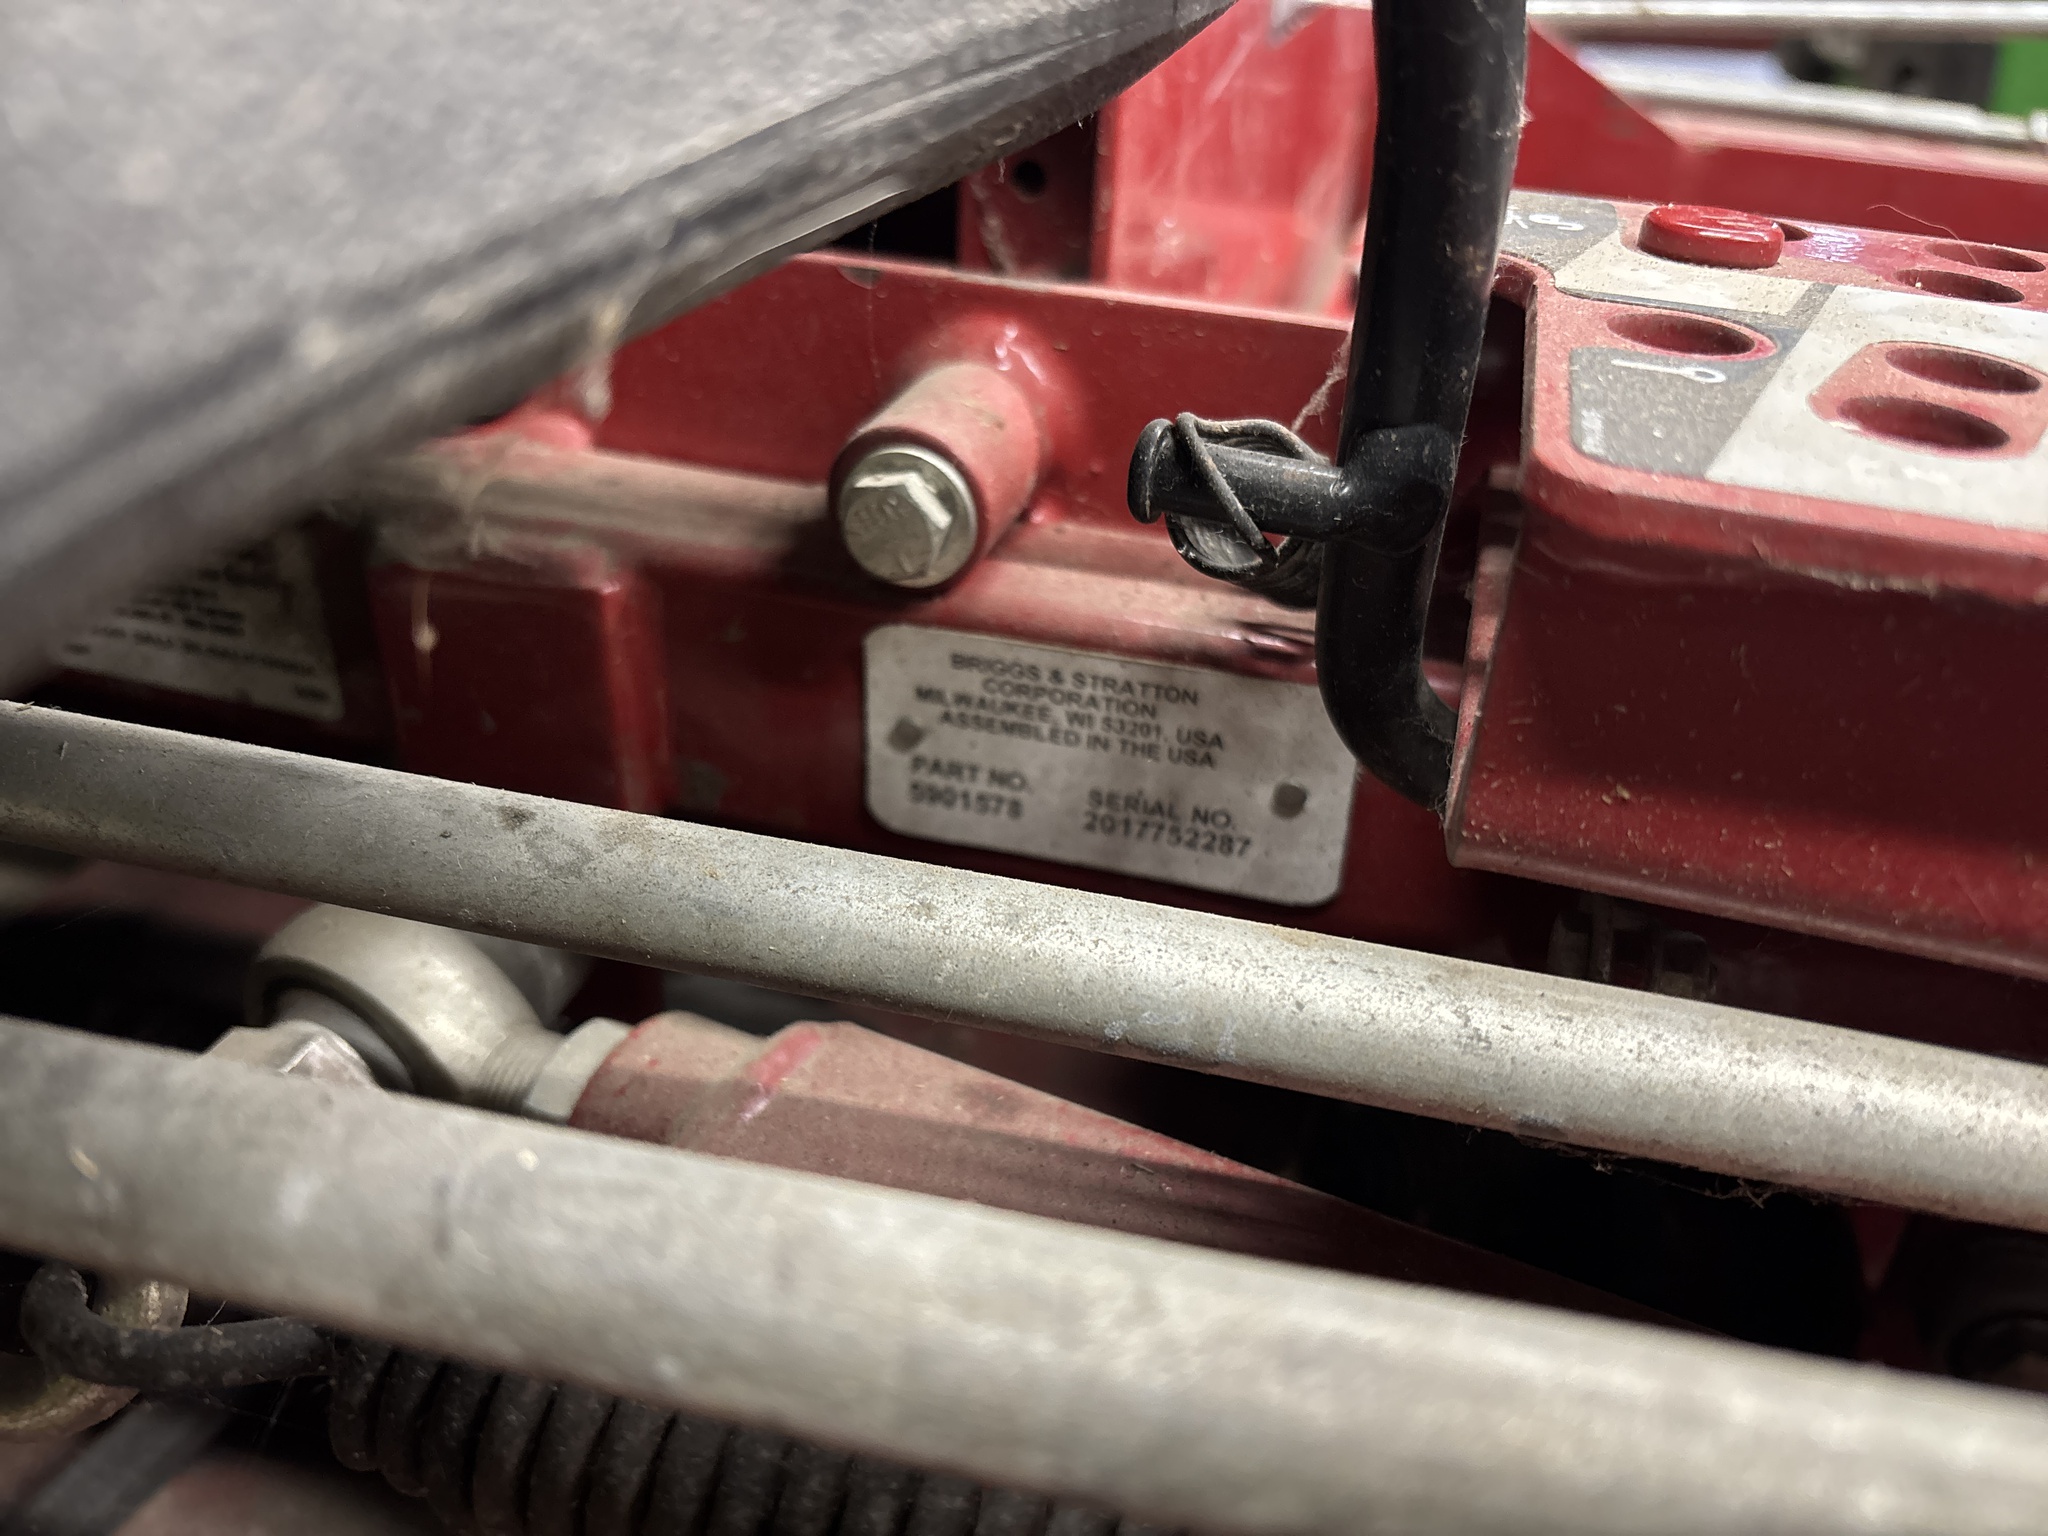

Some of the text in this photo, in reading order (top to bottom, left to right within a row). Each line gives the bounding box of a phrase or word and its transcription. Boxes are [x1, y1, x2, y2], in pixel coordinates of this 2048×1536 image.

[951, 653, 1199, 706] BRIGGS & STRATTON
[981, 677, 1157, 719] CORPORATION
[940, 711, 1216, 770] ASSEMBLED IN THE USA
[1066, 711, 1094, 729] WI
[1176, 725, 1225, 751] USA
[911, 754, 980, 783] PART
[1088, 788, 1179, 822] SERIAL
